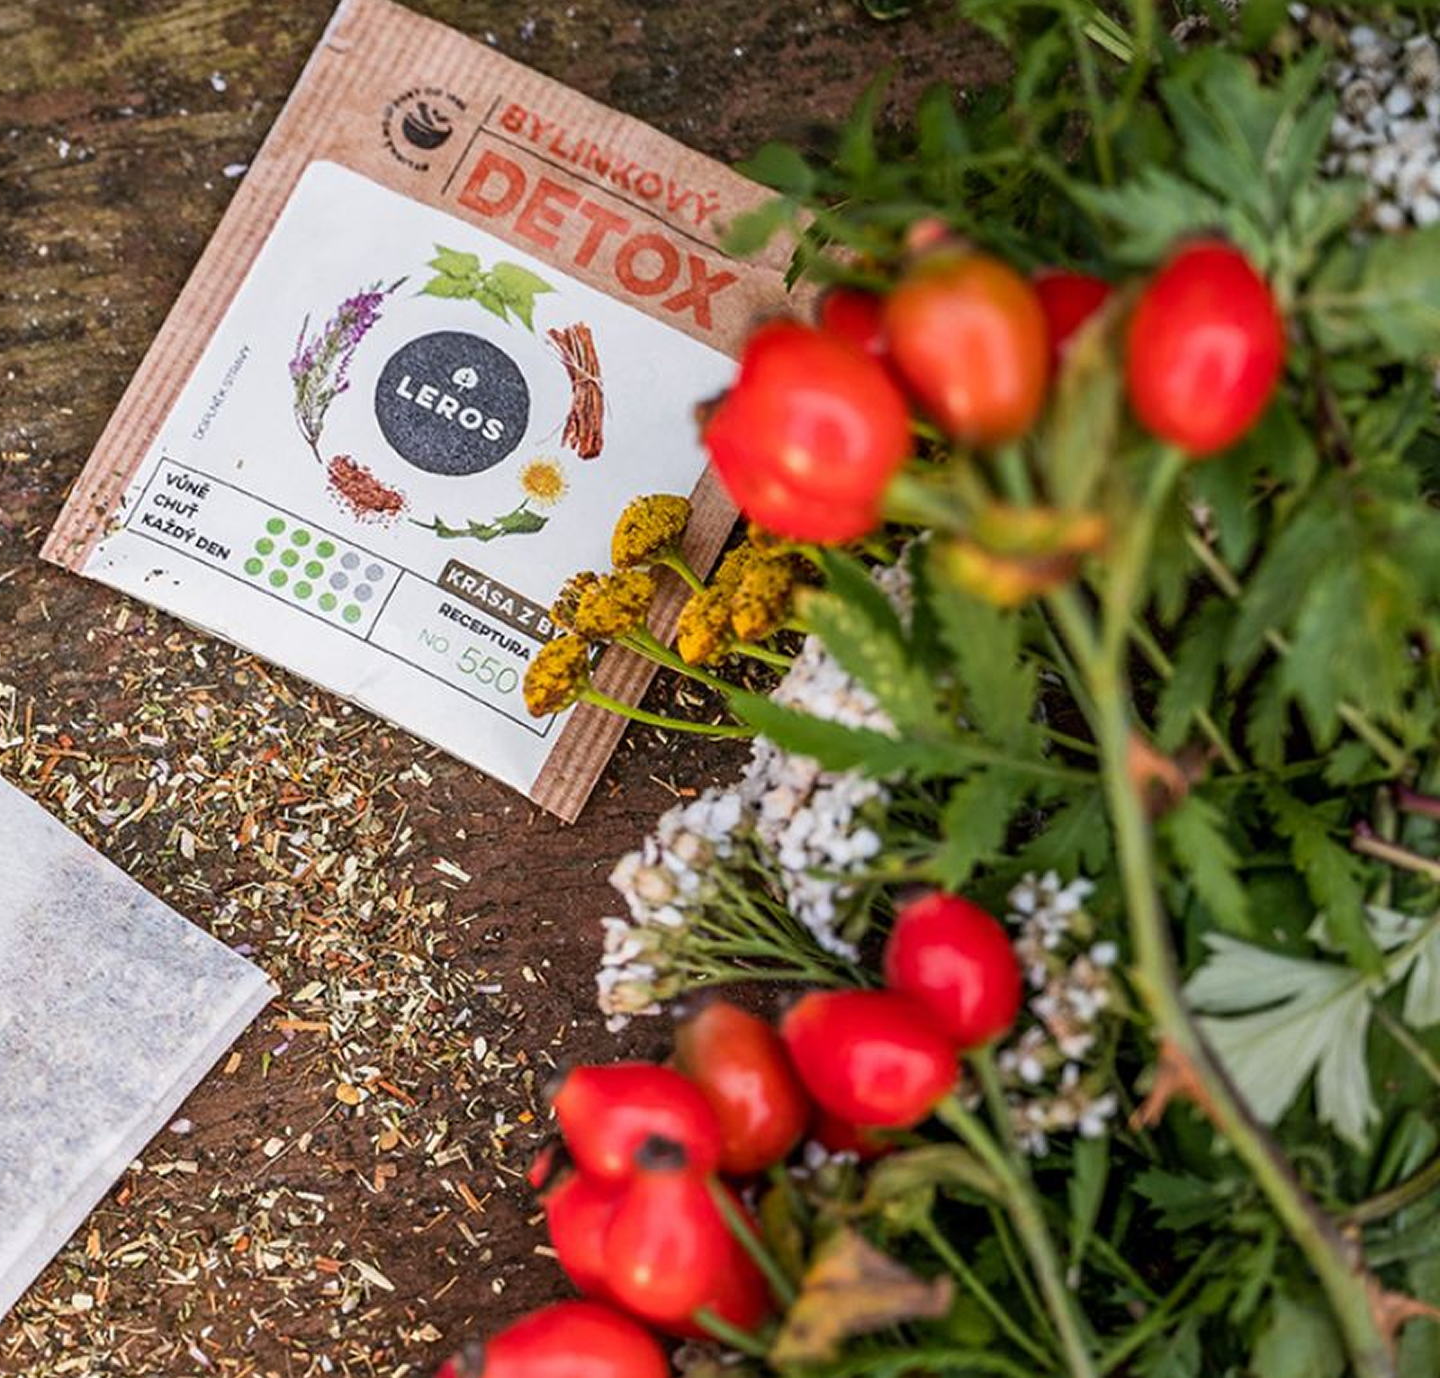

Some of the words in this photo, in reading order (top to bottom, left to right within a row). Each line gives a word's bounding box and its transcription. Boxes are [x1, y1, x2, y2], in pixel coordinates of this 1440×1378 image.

[500, 103, 719, 225] BYLINKOVÝ
[457, 149, 738, 331] DETOX
[396, 375, 504, 442] LEROS
[152, 493, 199, 519] CHUŤ
[165, 472, 210, 499] VŮNĚ
[141, 512, 197, 544] KAŽDÝ
[195, 536, 231, 561] DEN
[446, 566, 516, 617] KRÁSA
[516, 606, 534, 626] Z
[438, 602, 532, 662] RECEPTURA
[456, 645, 519, 695] 550
